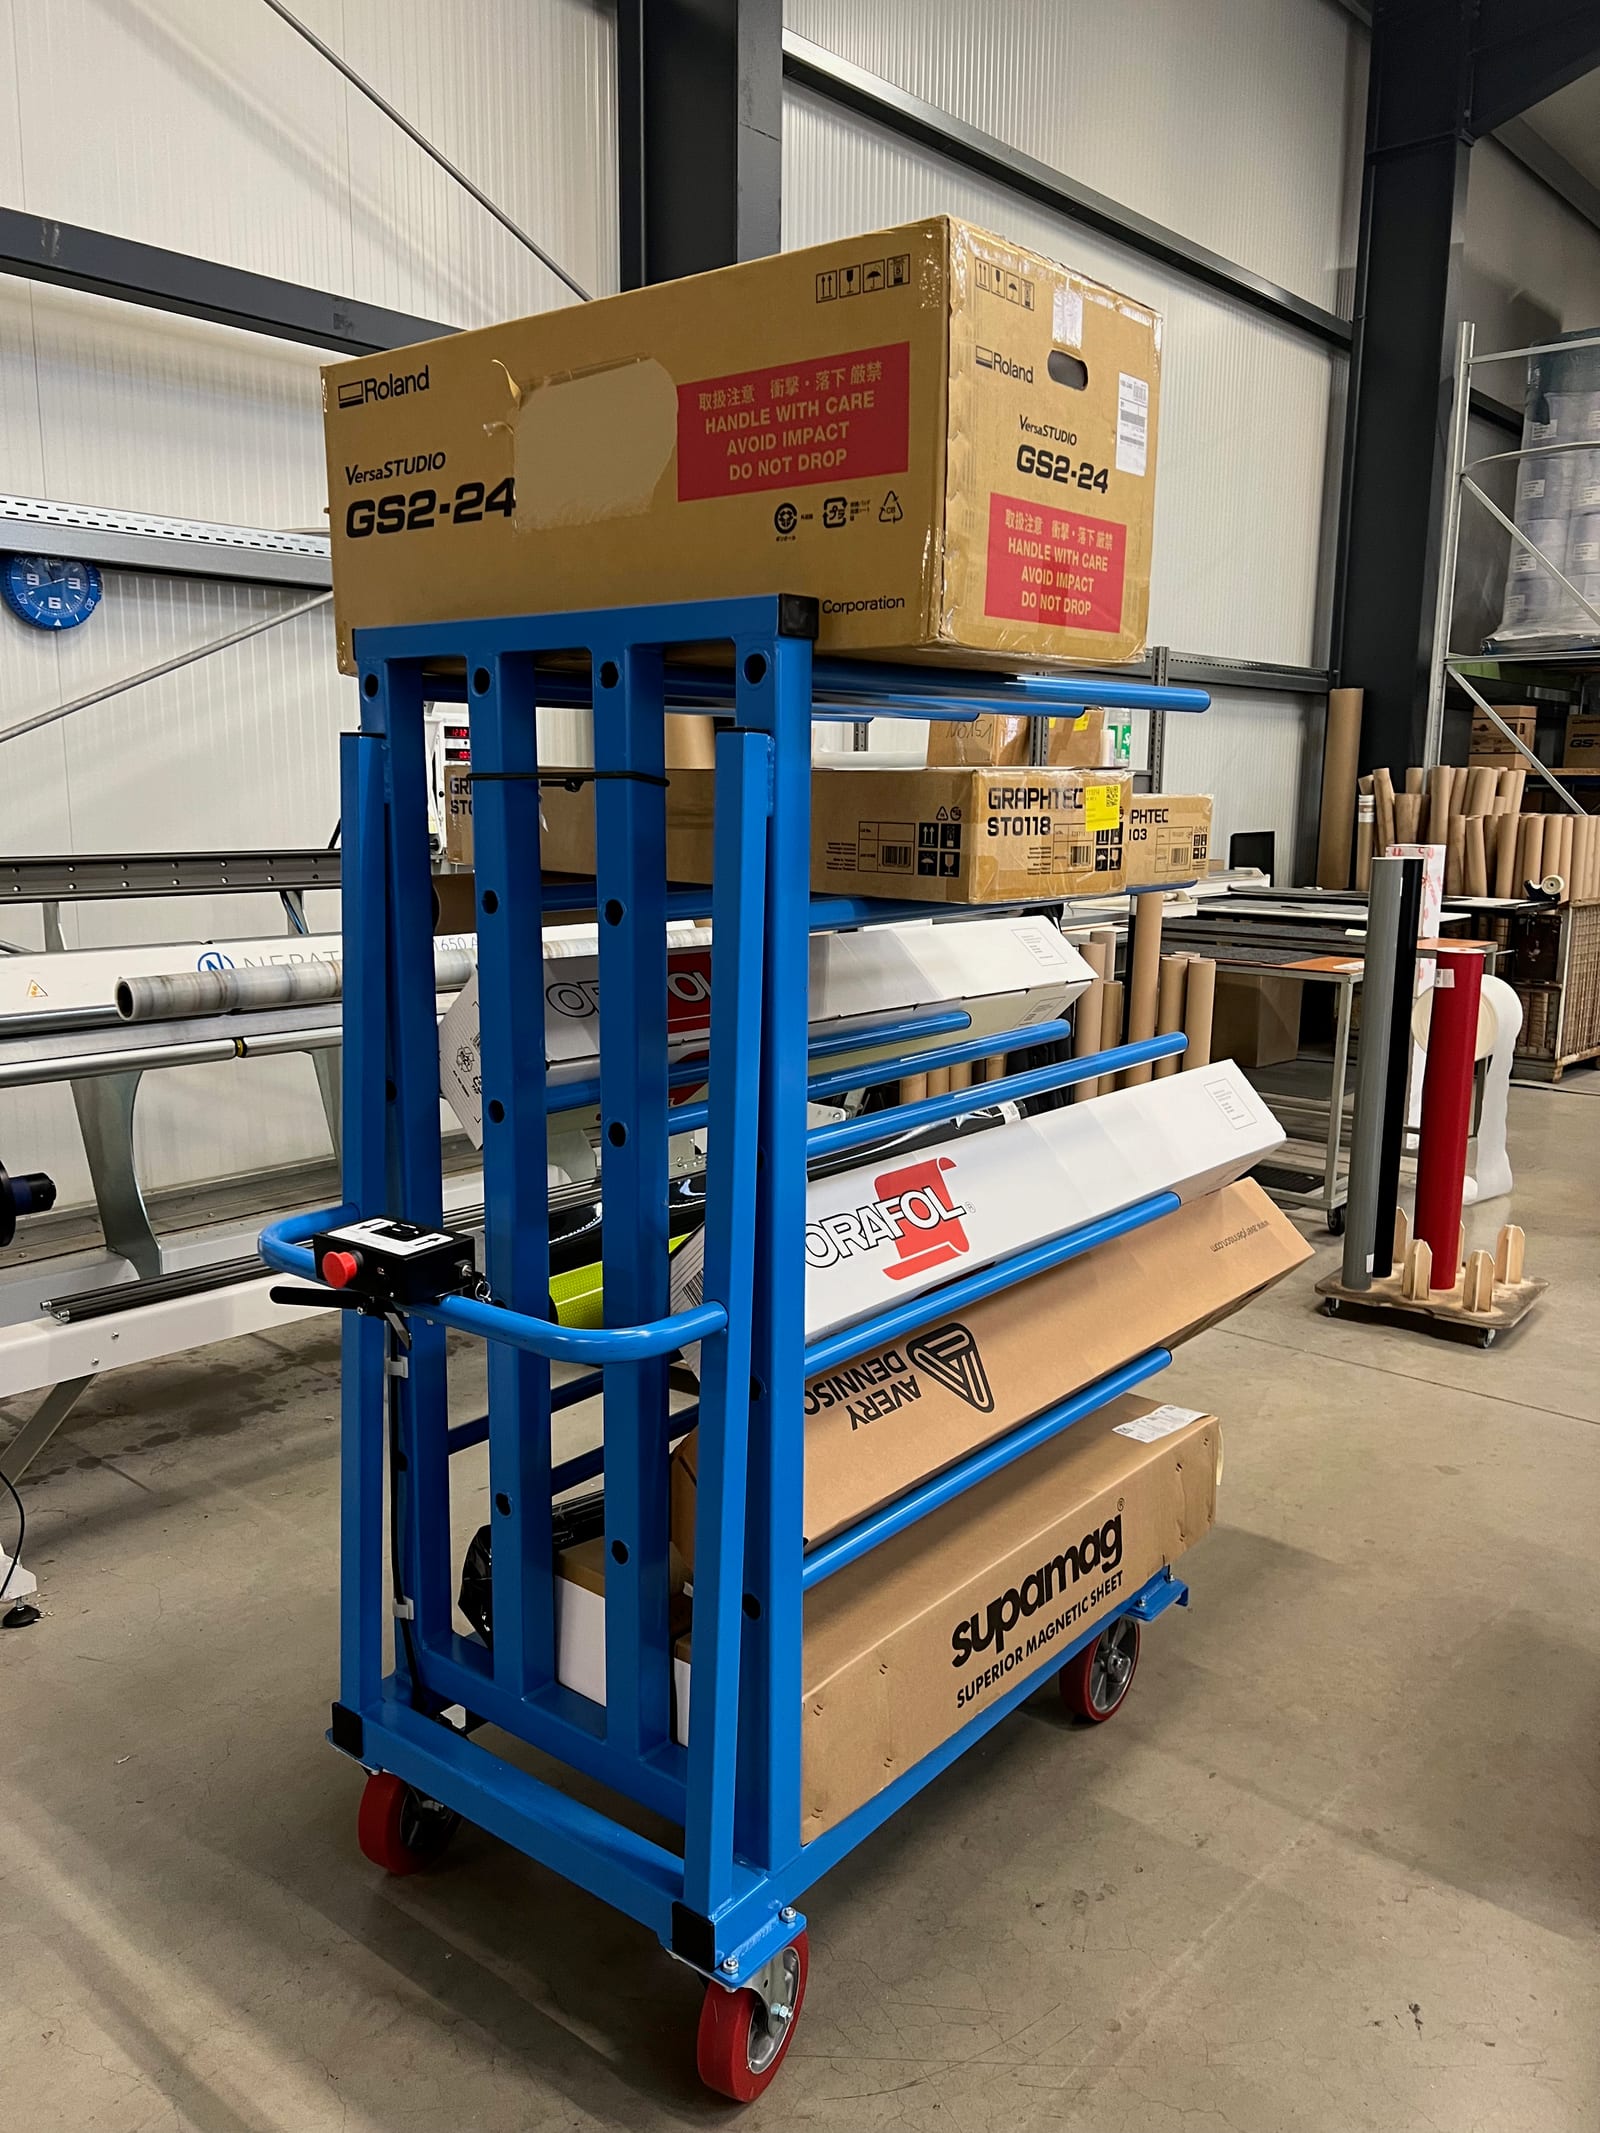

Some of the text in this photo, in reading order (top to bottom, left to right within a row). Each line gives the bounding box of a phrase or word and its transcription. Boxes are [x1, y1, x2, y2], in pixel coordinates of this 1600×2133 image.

[364, 364, 430, 403] Roland
[993, 351, 1034, 384] Roland
[698, 384, 755, 412] 取扱注意
[705, 390, 875, 435] HANDLE WITH CARE
[727, 421, 850, 456] AVOID IMPACT
[1019, 413, 1078, 446] VersaSTUDIO
[345, 451, 446, 486] VersaSTUDIO
[729, 448, 848, 481] DO NOT DROP
[1016, 444, 1109, 494] GS2-24
[346, 477, 516, 539] GS2-24
[1008, 537, 1109, 572] HANDLE WITH CARE
[1021, 565, 1095, 593] AVOID IMPACT
[48, 596, 62, 609] 6
[822, 595, 905, 615] Corporation
[1021, 590, 1092, 615] DO NOT DROP
[988, 787, 1083, 810] GRAPHTEC
[1130, 808, 1169, 824] PHTEC
[805, 1185, 967, 1268] ORAFOL
[845, 1374, 922, 1431] AVERY
[951, 1513, 1123, 1668] supamag
[956, 1569, 1123, 1709] SUPERIOR MAGNETIC SHEET
